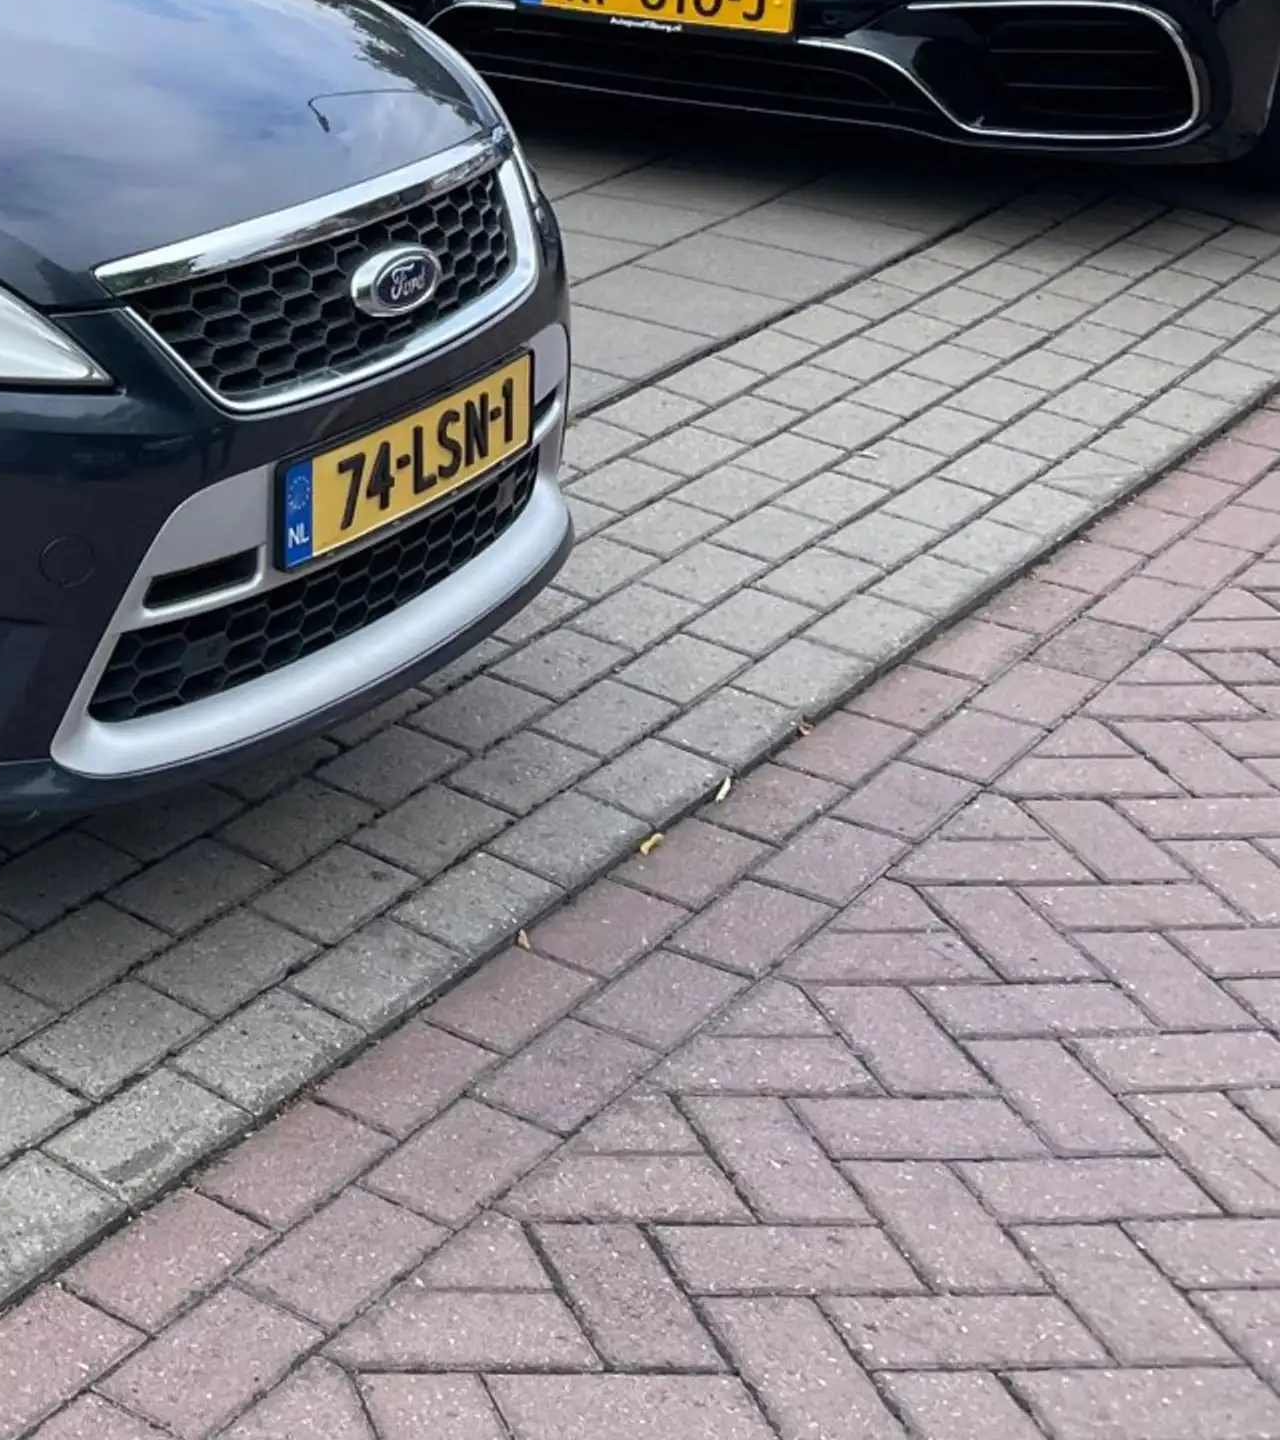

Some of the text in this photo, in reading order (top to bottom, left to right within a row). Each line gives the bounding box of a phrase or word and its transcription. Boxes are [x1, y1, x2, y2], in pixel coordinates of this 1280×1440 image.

[391, 262, 426, 300] Ford
[338, 378, 514, 530] 74-LSN-1
[287, 524, 310, 549] NL
